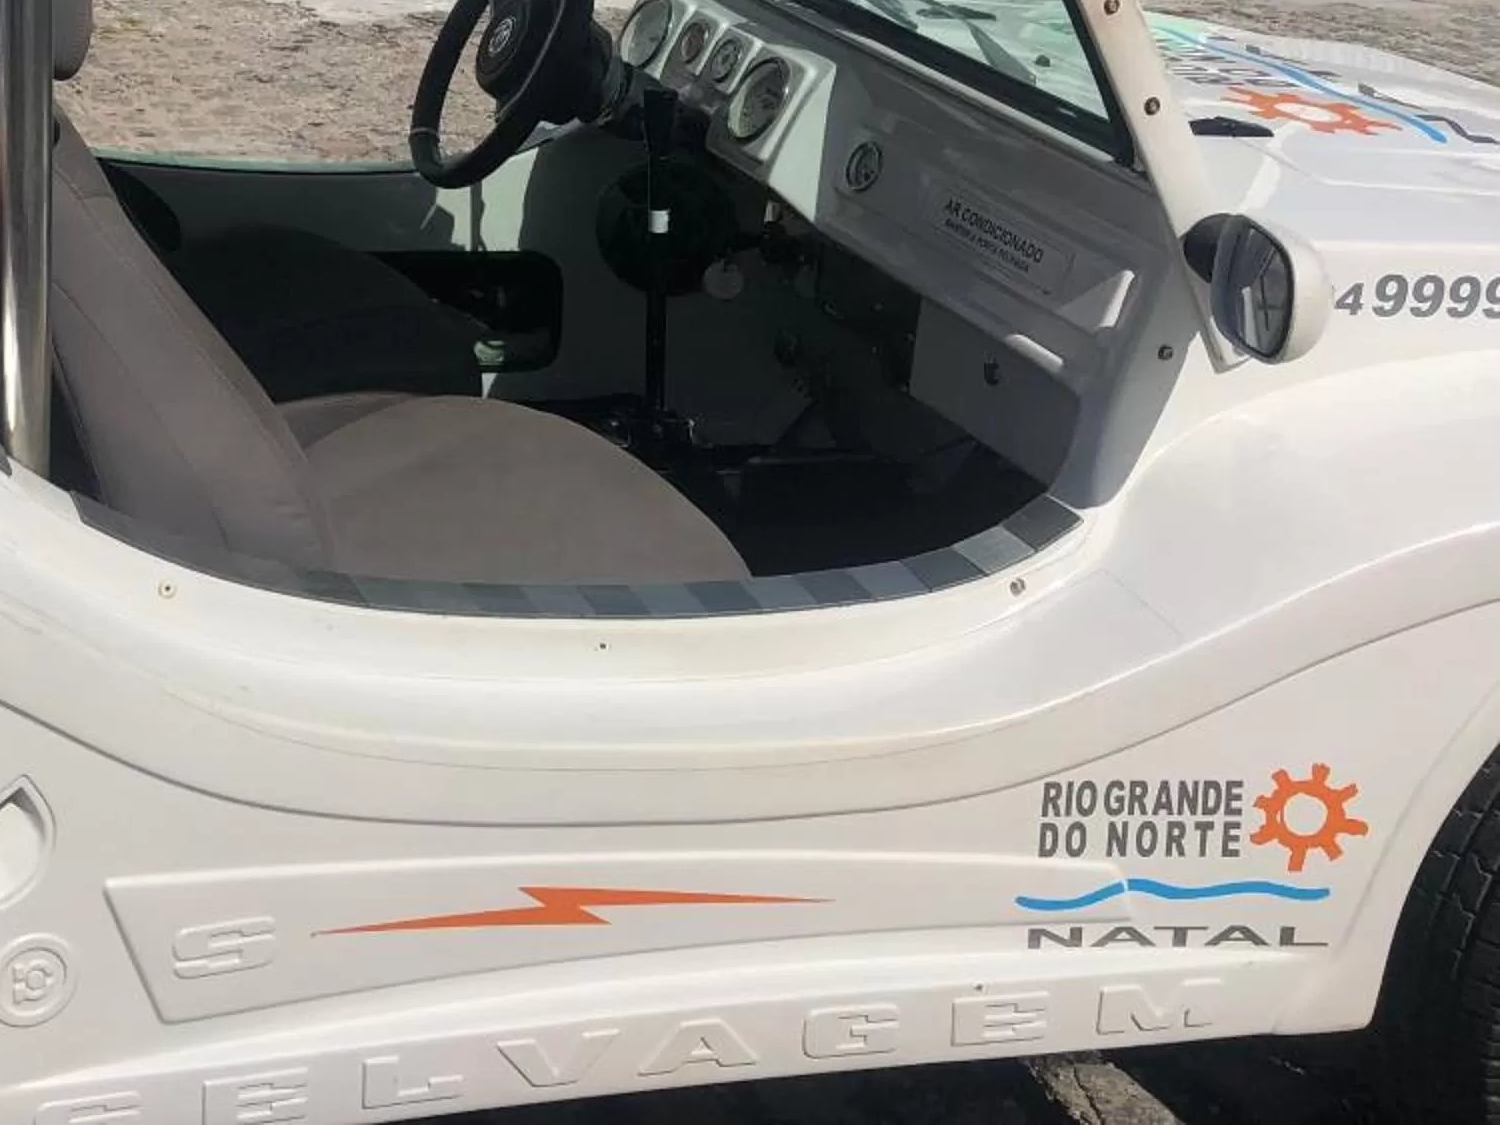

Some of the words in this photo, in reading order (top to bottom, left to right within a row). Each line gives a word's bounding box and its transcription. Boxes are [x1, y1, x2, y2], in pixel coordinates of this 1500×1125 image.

[1332, 282, 1365, 316] 4
[1041, 780, 1098, 818] RIO
[1103, 779, 1244, 817] GRANDE
[1037, 822, 1087, 858] DO
[1105, 821, 1241, 858] NORTE
[1027, 925, 1329, 950] NATAL
